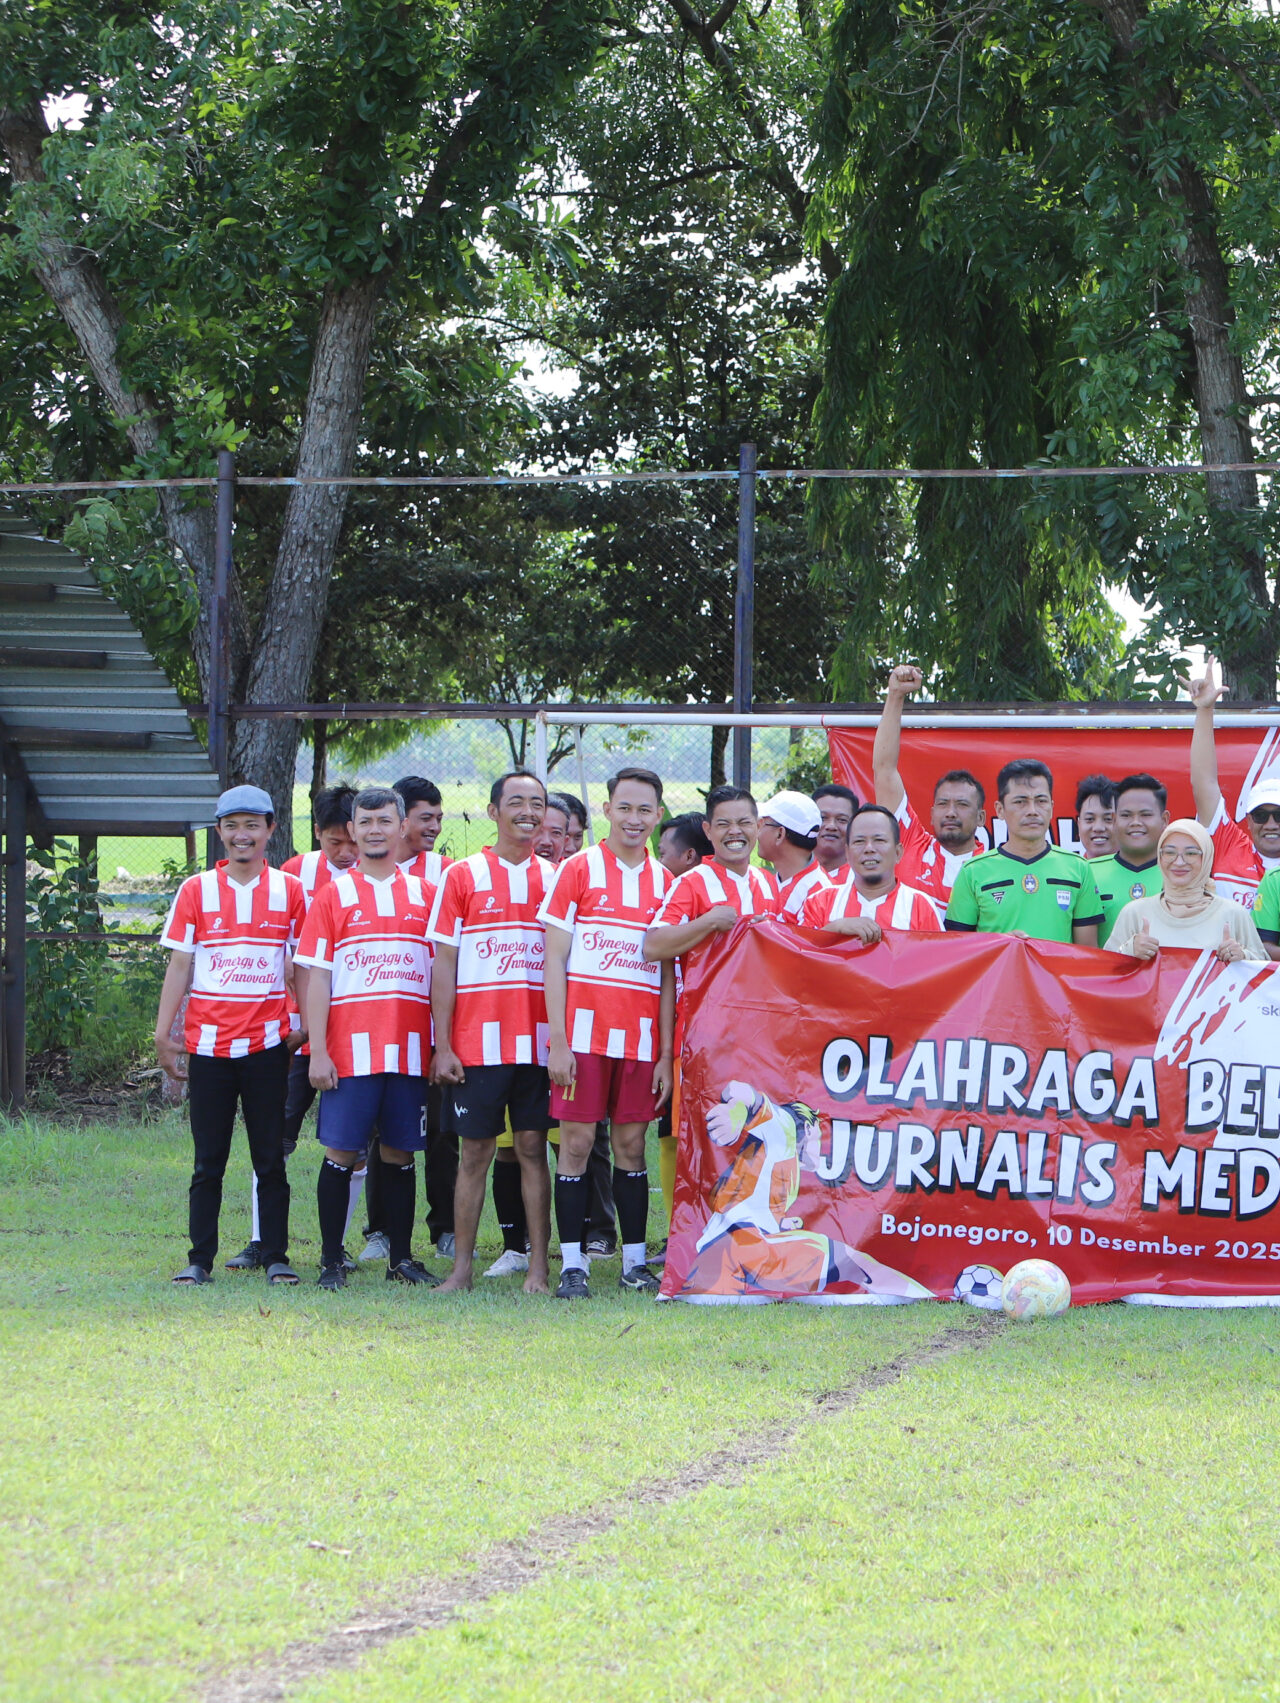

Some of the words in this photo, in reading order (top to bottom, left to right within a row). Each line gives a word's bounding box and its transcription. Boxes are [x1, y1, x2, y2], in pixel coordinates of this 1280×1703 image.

[344, 948, 402, 971] Synergy
[403, 953, 414, 966] &
[582, 930, 639, 955] Synergy
[256, 957, 269, 970] &
[820, 1035, 1159, 1127] OLAHRAGA
[815, 1119, 1117, 1209] JURNALIS
[881, 1214, 1037, 1247] Bojonegoro,
[1047, 1225, 1072, 1246] 10
[1080, 1228, 1205, 1257] Desember
